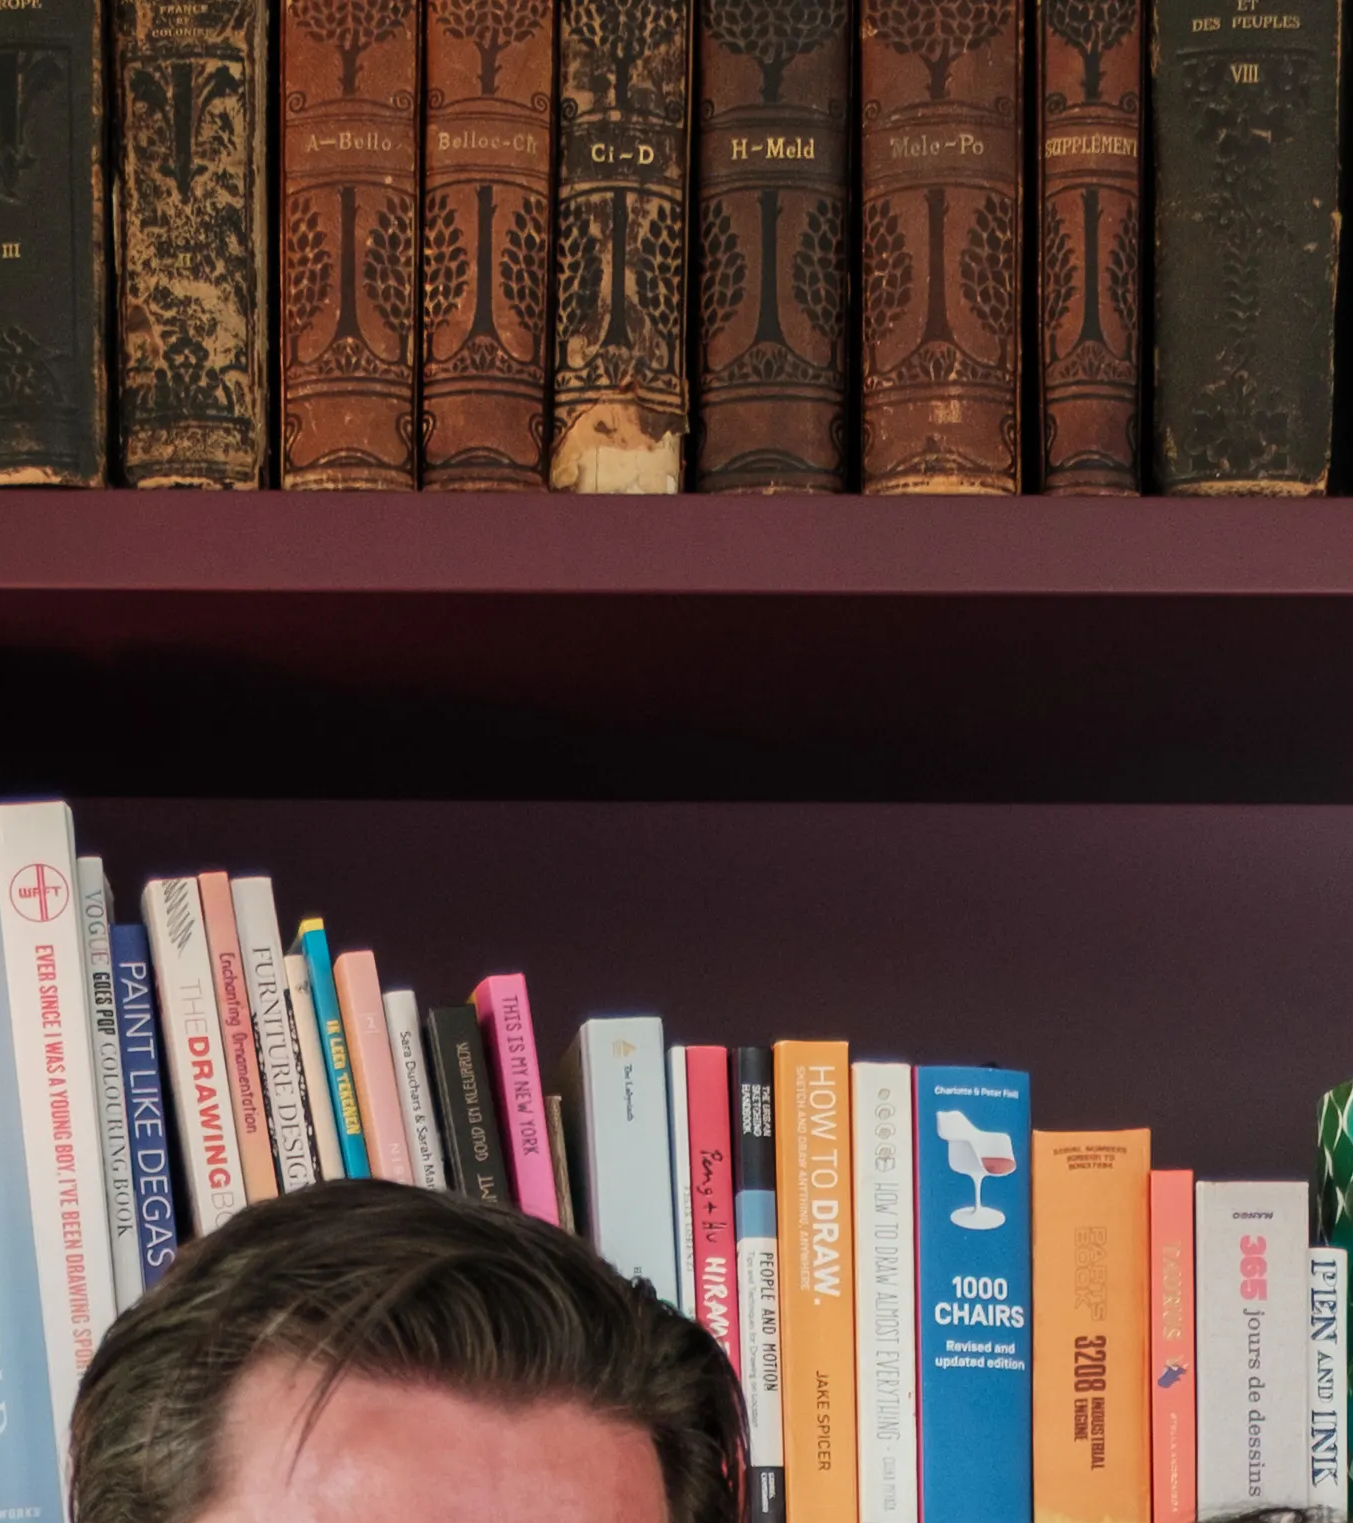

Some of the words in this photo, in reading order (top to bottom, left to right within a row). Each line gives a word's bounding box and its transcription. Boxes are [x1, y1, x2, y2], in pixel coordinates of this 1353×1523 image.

[1192, 18, 1221, 32] DES
[1232, 15, 1301, 29] PEUPLES
[1230, 63, 1260, 84] VIII
[1, 243, 21, 259] III
[84, 889, 110, 966] VOGUE
[35, 944, 56, 982] EVER
[39, 984, 62, 1029] SINCE
[92, 971, 113, 1006] GOES
[119, 962, 155, 1059] PAINT
[180, 977, 208, 1035] THE
[96, 1009, 116, 1036] POP
[252, 946, 294, 1097] FURNITURE
[501, 994, 523, 1031] THIS
[45, 1040, 66, 1074] WAS
[219, 952, 245, 1027] Enchanting
[232, 1032, 260, 1134] Ornamentation
[400, 1030, 412, 1058] Sara
[506, 1035, 526, 1054] IS
[511, 1056, 529, 1077] MY
[49, 1077, 67, 1088] A
[129, 1069, 163, 1139] LIKE
[337, 1072, 362, 1135] TEKENEN
[405, 1060, 422, 1113] Duchars
[514, 1080, 535, 1115] NEW
[796, 1066, 806, 1109] SKETCH
[808, 1065, 838, 1141] HOW
[50, 1090, 73, 1141] YOUNG
[101, 1042, 128, 1172] COLOURING
[187, 1035, 231, 1189] DRAWING
[415, 1114, 426, 1125] &
[741, 1083, 752, 1135] HANDBOOK
[752, 1084, 762, 1137] SKETCHING
[797, 1111, 807, 1134] AND
[416, 1126, 431, 1163] Sarah
[517, 1116, 540, 1156] YORK
[798, 1136, 808, 1168] DRAW
[59, 1177, 79, 1207] I'VE
[811, 1148, 839, 1189] TO
[113, 1178, 134, 1237] BOOK
[137, 1148, 176, 1267] DEGAS
[874, 1183, 899, 1217] HOW
[61, 1210, 83, 1251] BEEN
[811, 1200, 841, 1306] DRAW.
[874, 1223, 899, 1240] TO
[65, 1253, 90, 1325] DRAWING
[759, 1252, 776, 1301] PEOPLE
[875, 1246, 899, 1287] DRAW
[952, 1275, 1008, 1300] 1000
[1074, 1226, 1092, 1310] BOOK
[1090, 1226, 1108, 1321] PARTS
[1239, 1234, 1268, 1301] 365
[1162, 1240, 1183, 1341] TAURUS
[1310, 1258, 1338, 1346] PEN
[761, 1308, 777, 1335] AND
[875, 1291, 900, 1345] ALMOST
[934, 1302, 1025, 1328] CHAIRS
[1243, 1307, 1265, 1370] jours
[762, 1343, 779, 1392] MOTION
[935, 1356, 985, 1369] updated
[987, 1357, 1025, 1371] edition
[946, 1340, 992, 1353] Revised
[994, 1342, 1016, 1354] and
[1074, 1335, 1107, 1393] 3208
[816, 1370, 830, 1410] JAKE
[875, 1350, 902, 1441] EVERYTHING
[1247, 1374, 1266, 1404] de
[1317, 1350, 1334, 1403] AND
[816, 1414, 831, 1472] SPICER
[1074, 1397, 1089, 1442] ENGINE
[1090, 1396, 1105, 1471] INDUSTRIAL
[1248, 1408, 1267, 1498] dessins
[1310, 1409, 1339, 1488] INK
